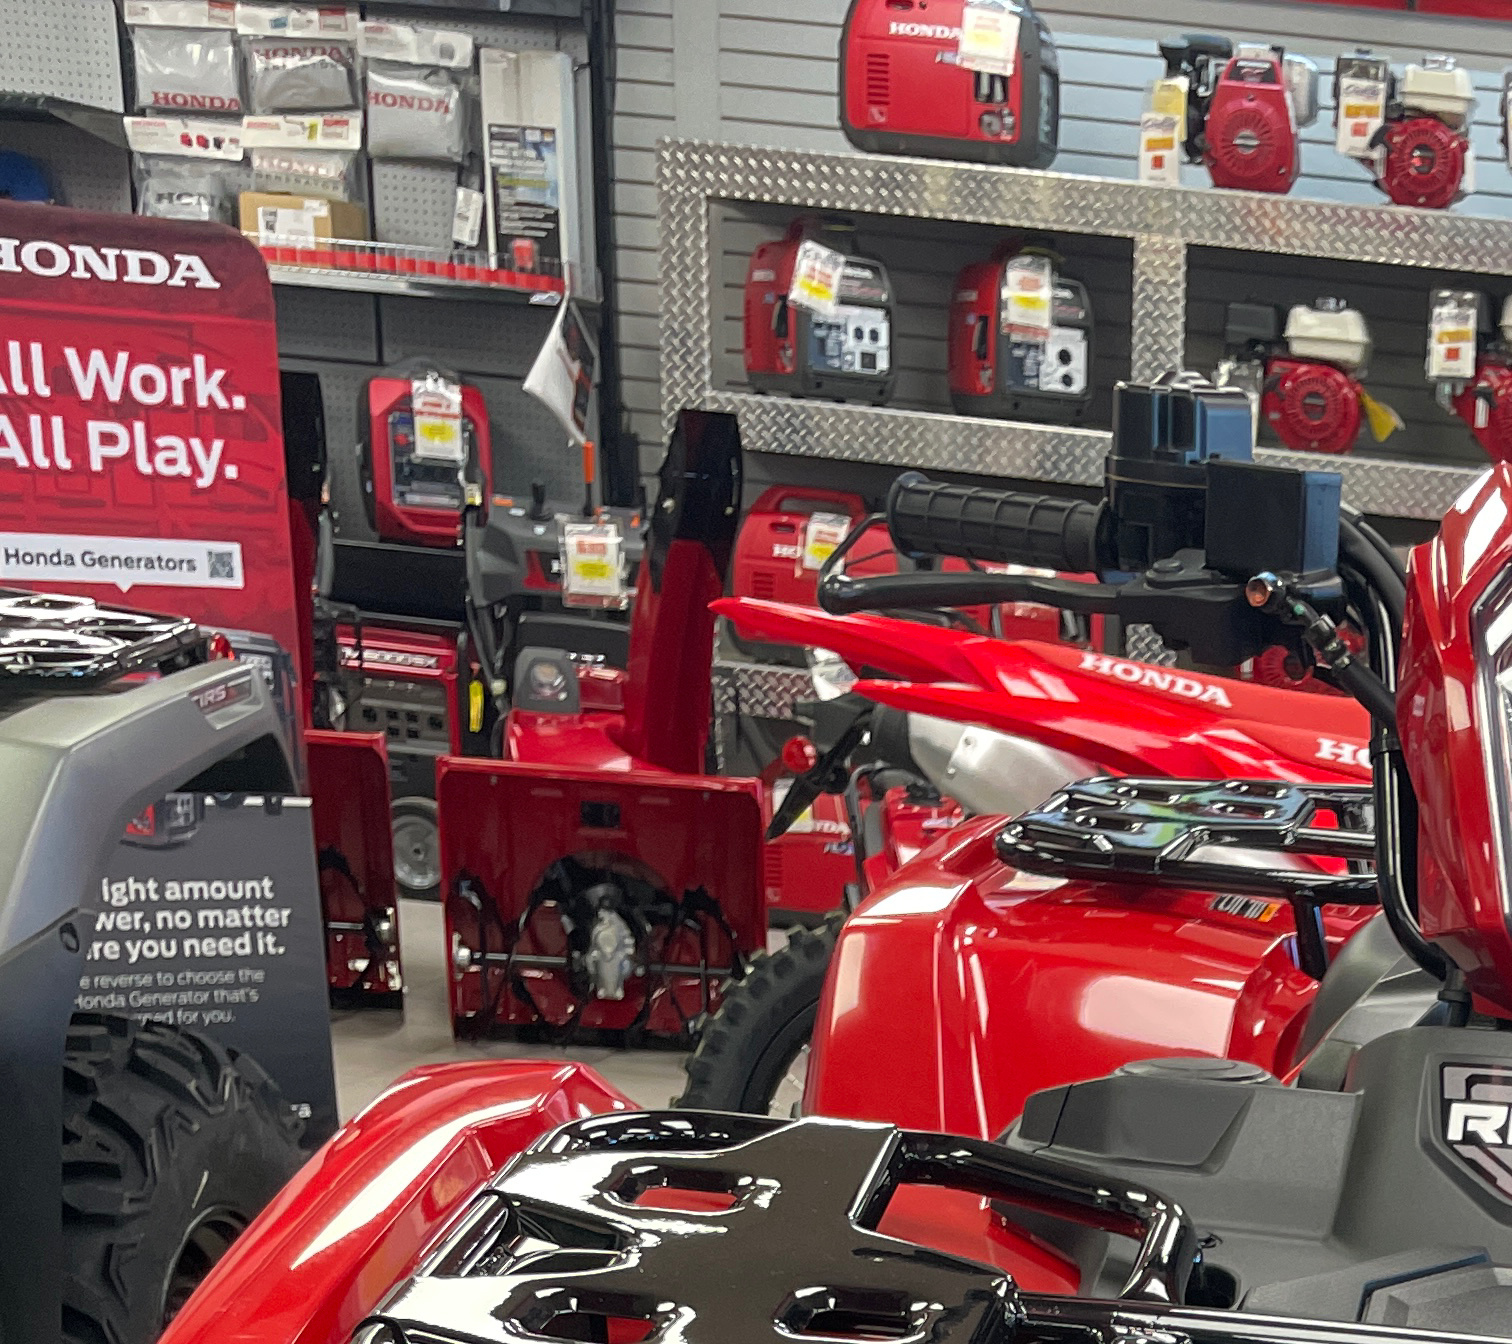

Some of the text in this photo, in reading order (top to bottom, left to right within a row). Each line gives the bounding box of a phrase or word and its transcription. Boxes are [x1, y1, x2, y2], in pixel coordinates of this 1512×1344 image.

[151, 91, 240, 111] HONDA
[367, 90, 450, 115] HONDA
[0, 340, 247, 410] ll Work.
[86, 419, 239, 489] Play.
[4, 547, 197, 573] Honda Generators
[1079, 653, 1233, 708] HONDA
[101, 875, 275, 907] ight amount
[95, 904, 292, 934] wer, no matter
[125, 937, 177, 964] you
[182, 931, 251, 958] need
[256, 930, 286, 956] it.
